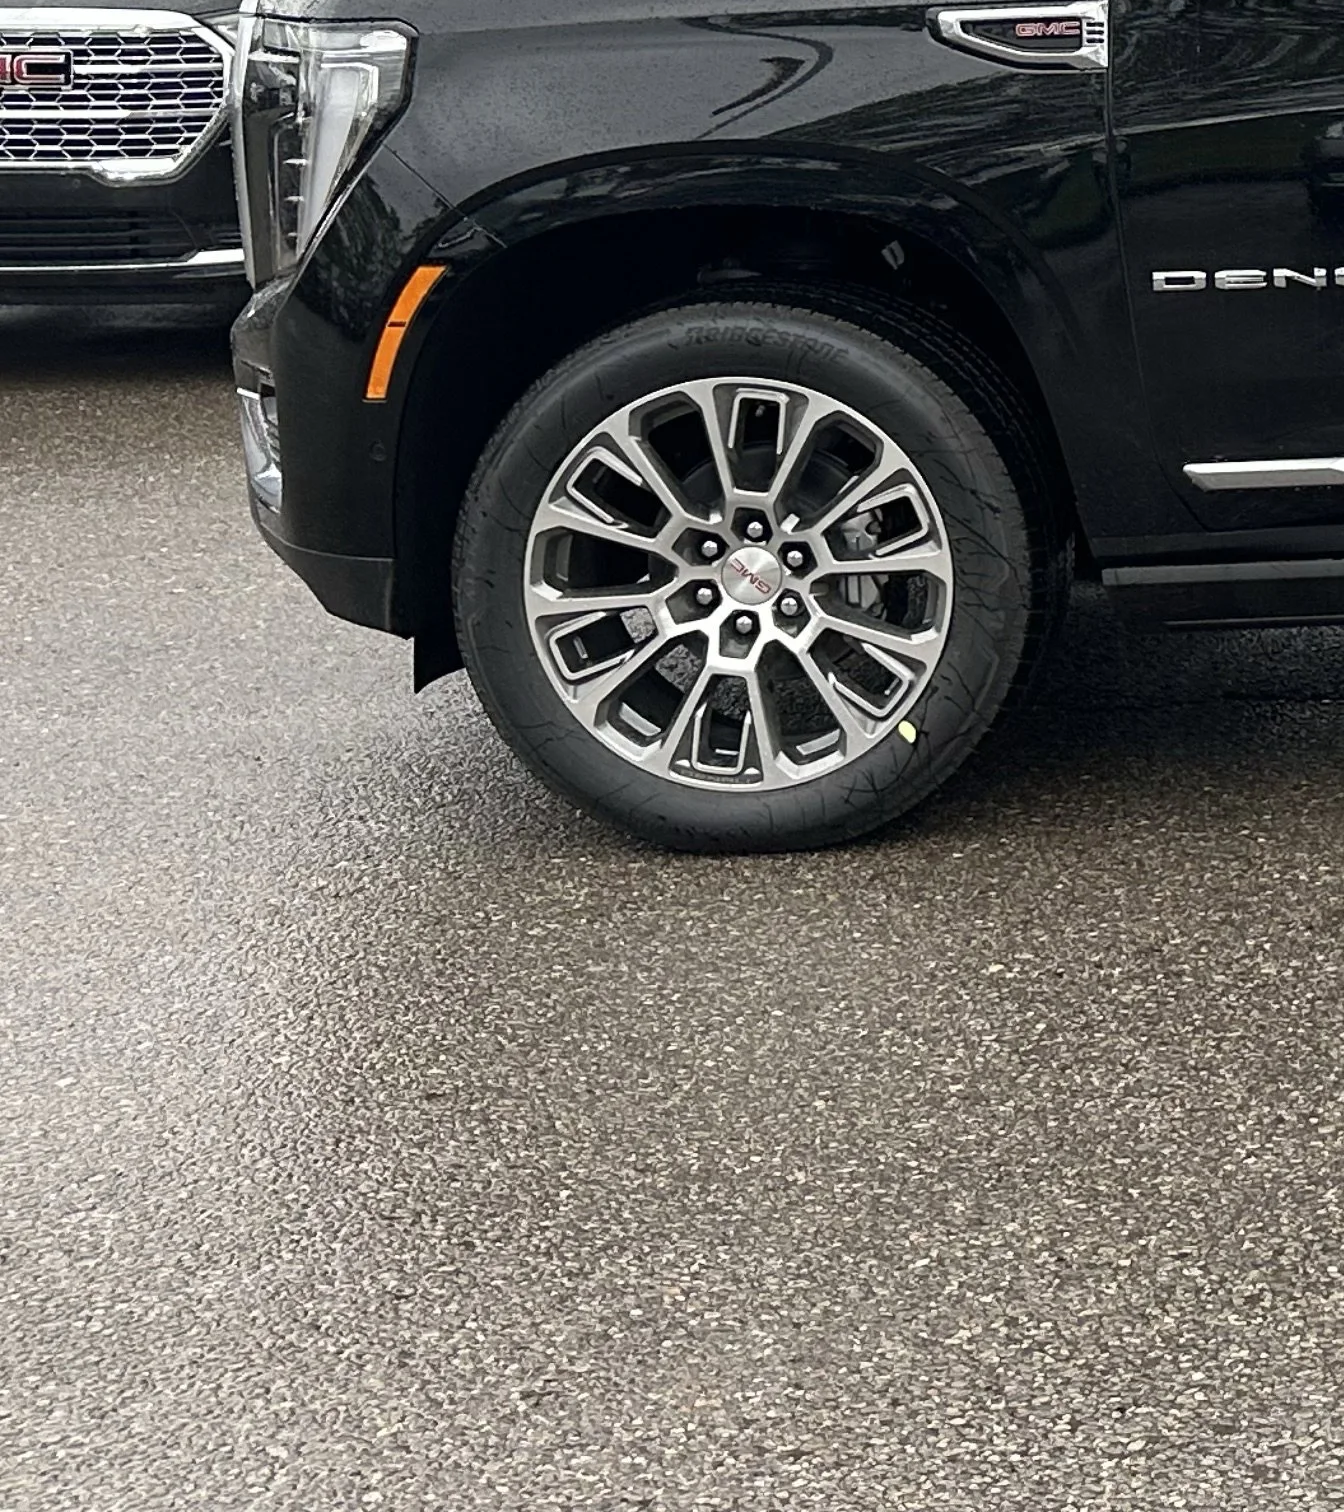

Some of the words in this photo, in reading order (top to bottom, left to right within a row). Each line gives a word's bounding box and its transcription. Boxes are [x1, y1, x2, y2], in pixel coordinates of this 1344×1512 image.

[1015, 21, 1081, 37] GMC
[0, 54, 66, 84] C
[729, 558, 772, 595] GMC
